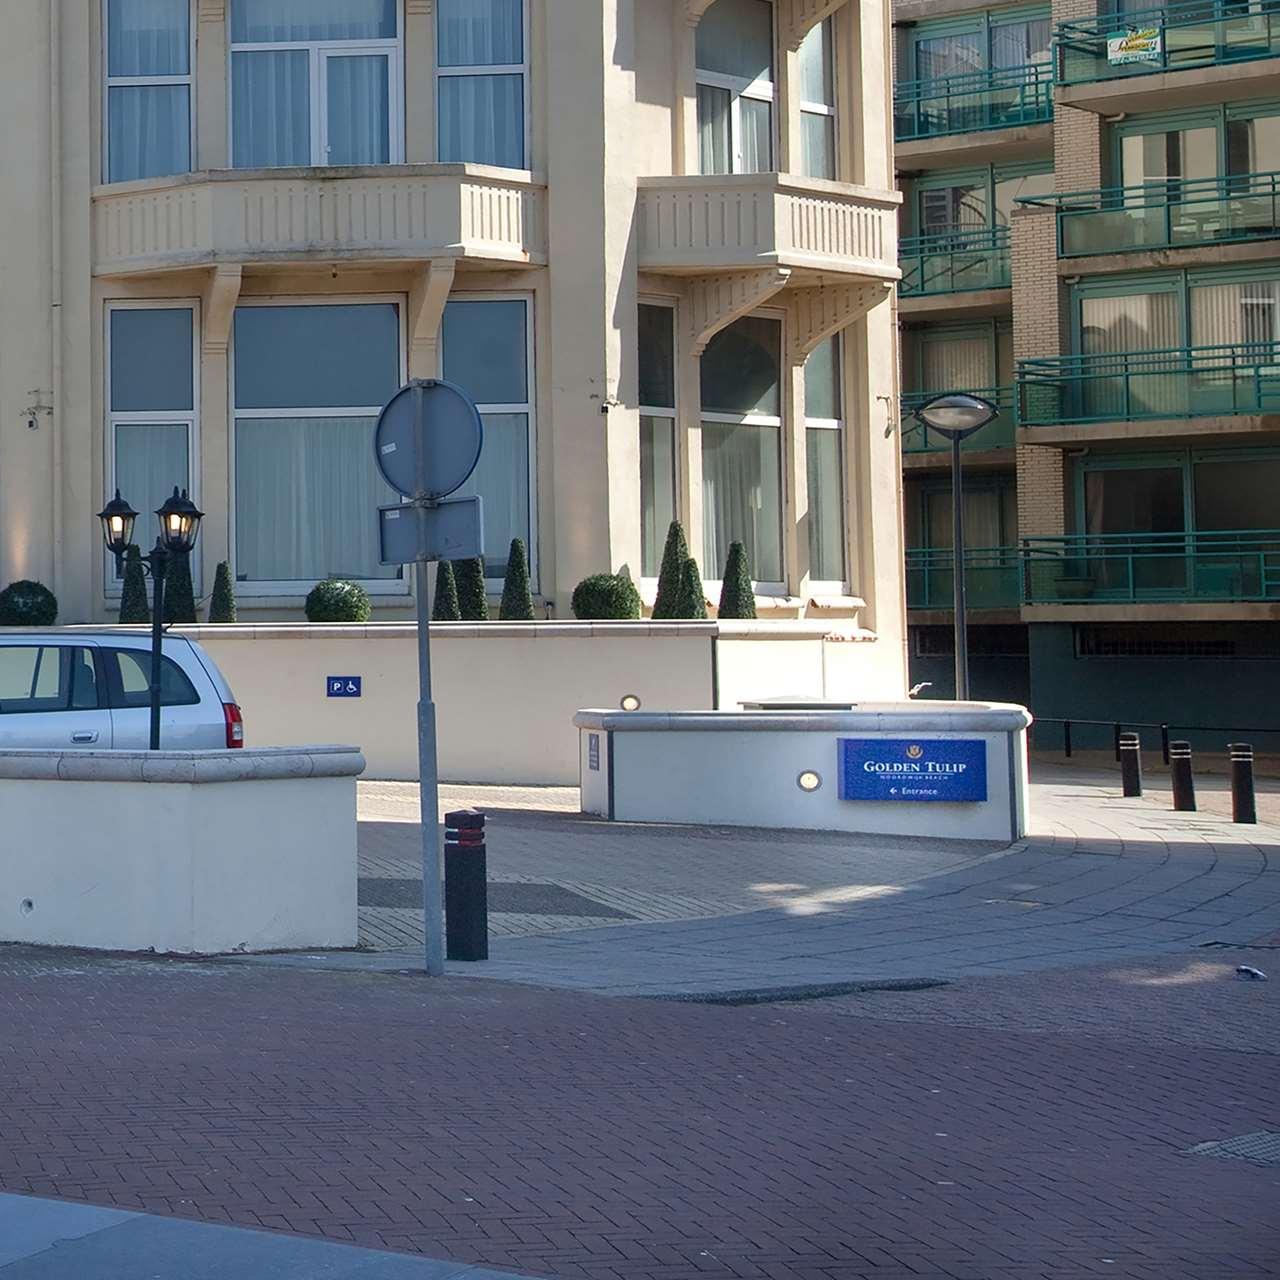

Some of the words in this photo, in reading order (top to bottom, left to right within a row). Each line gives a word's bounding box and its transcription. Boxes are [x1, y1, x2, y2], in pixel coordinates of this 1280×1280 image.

[333, 682, 341, 691] P
[863, 760, 920, 772] GOLDEN
[925, 761, 967, 773] TULIP
[901, 786, 938, 795] Entrance
